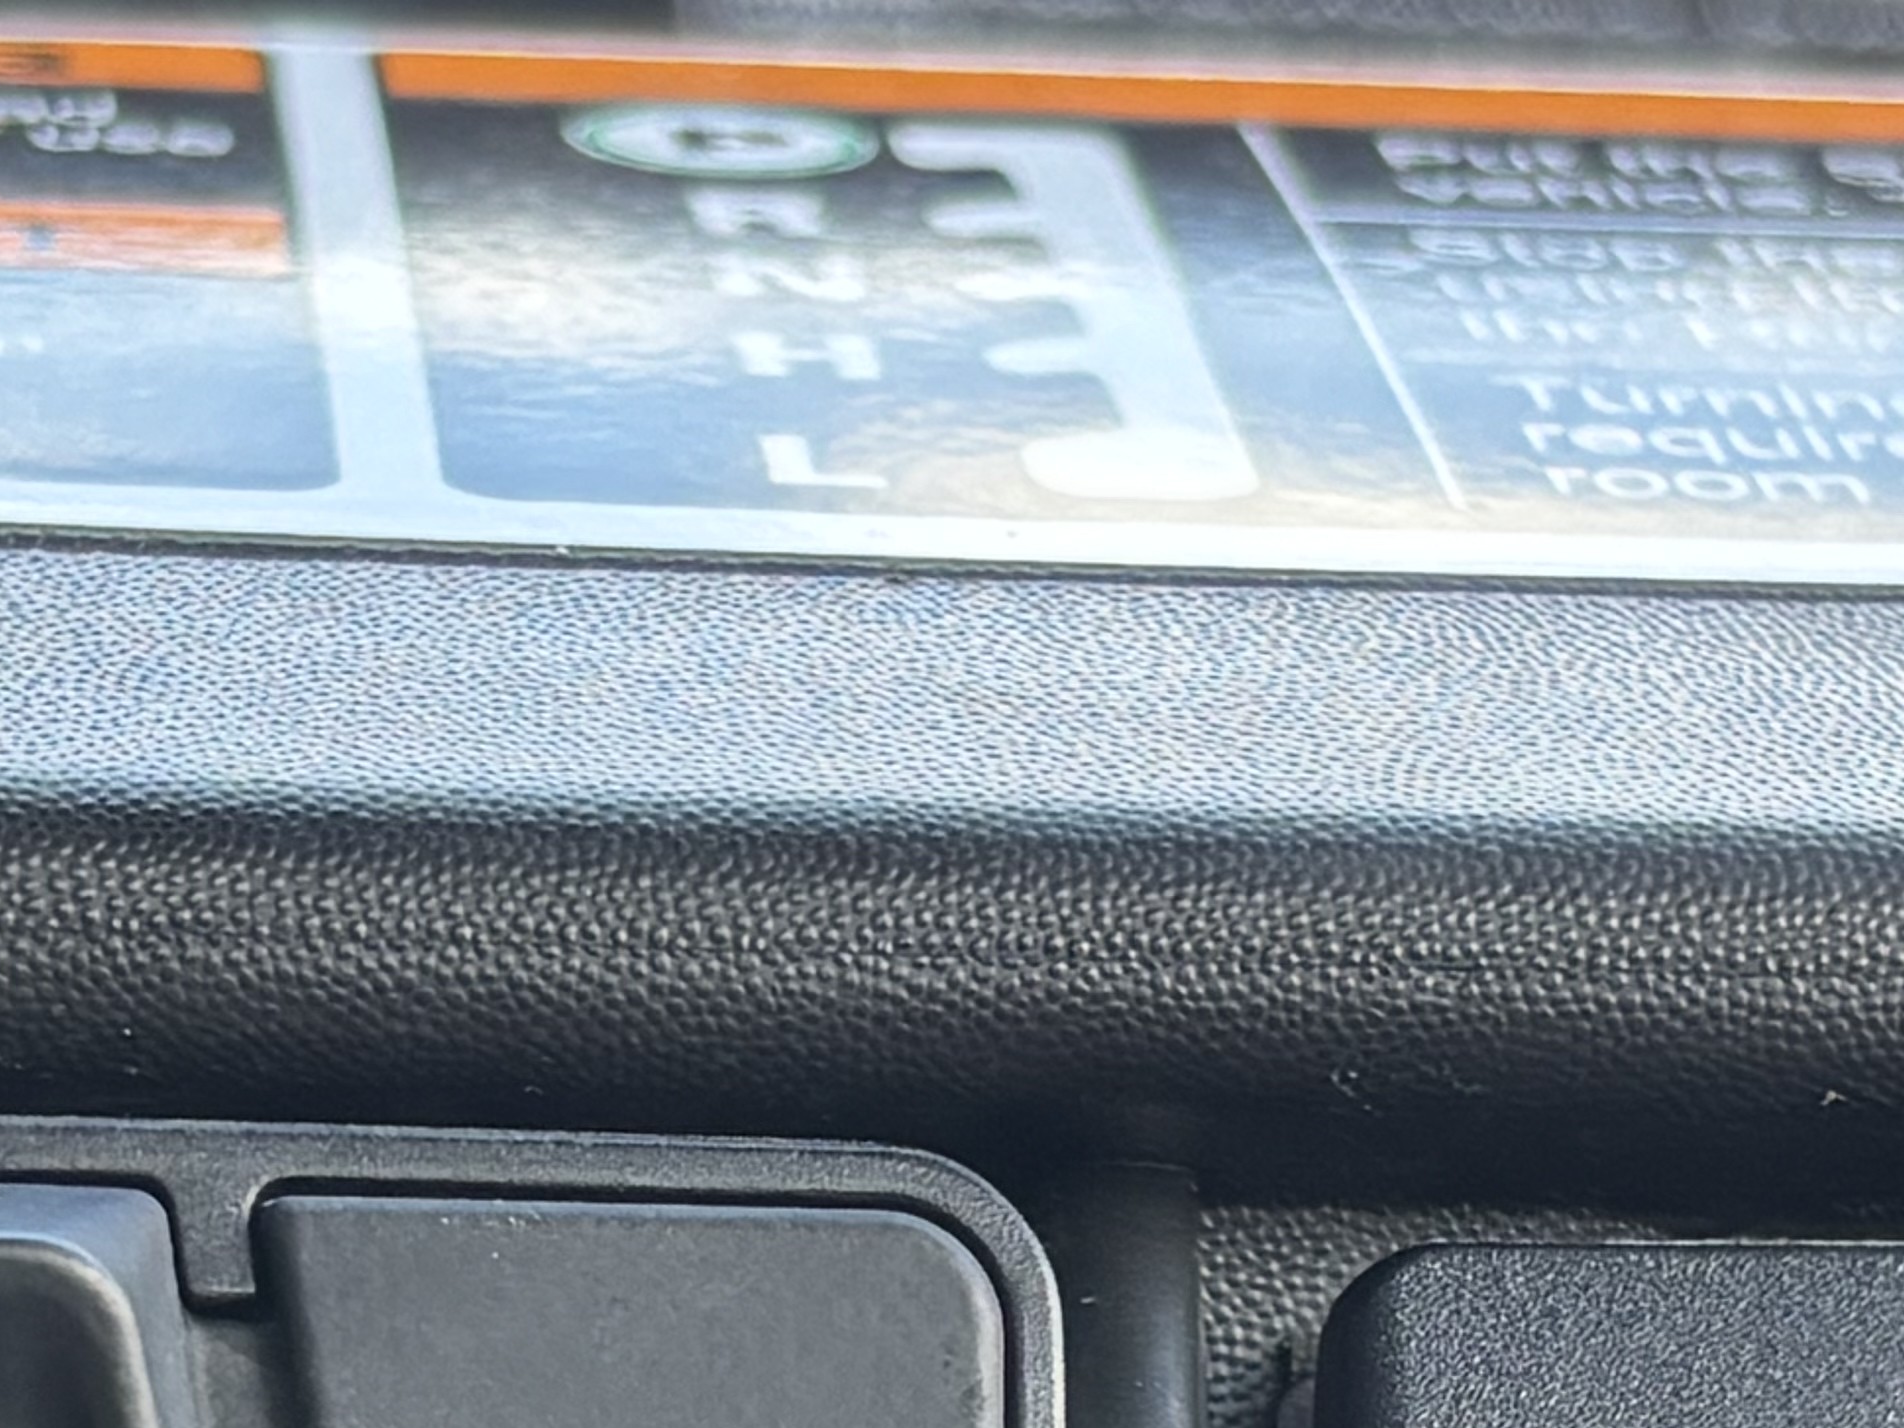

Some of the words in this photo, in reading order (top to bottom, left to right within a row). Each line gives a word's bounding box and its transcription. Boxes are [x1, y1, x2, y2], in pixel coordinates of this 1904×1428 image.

[731, 333, 883, 379] H
[756, 433, 886, 489] L
[1543, 462, 1874, 499] room
